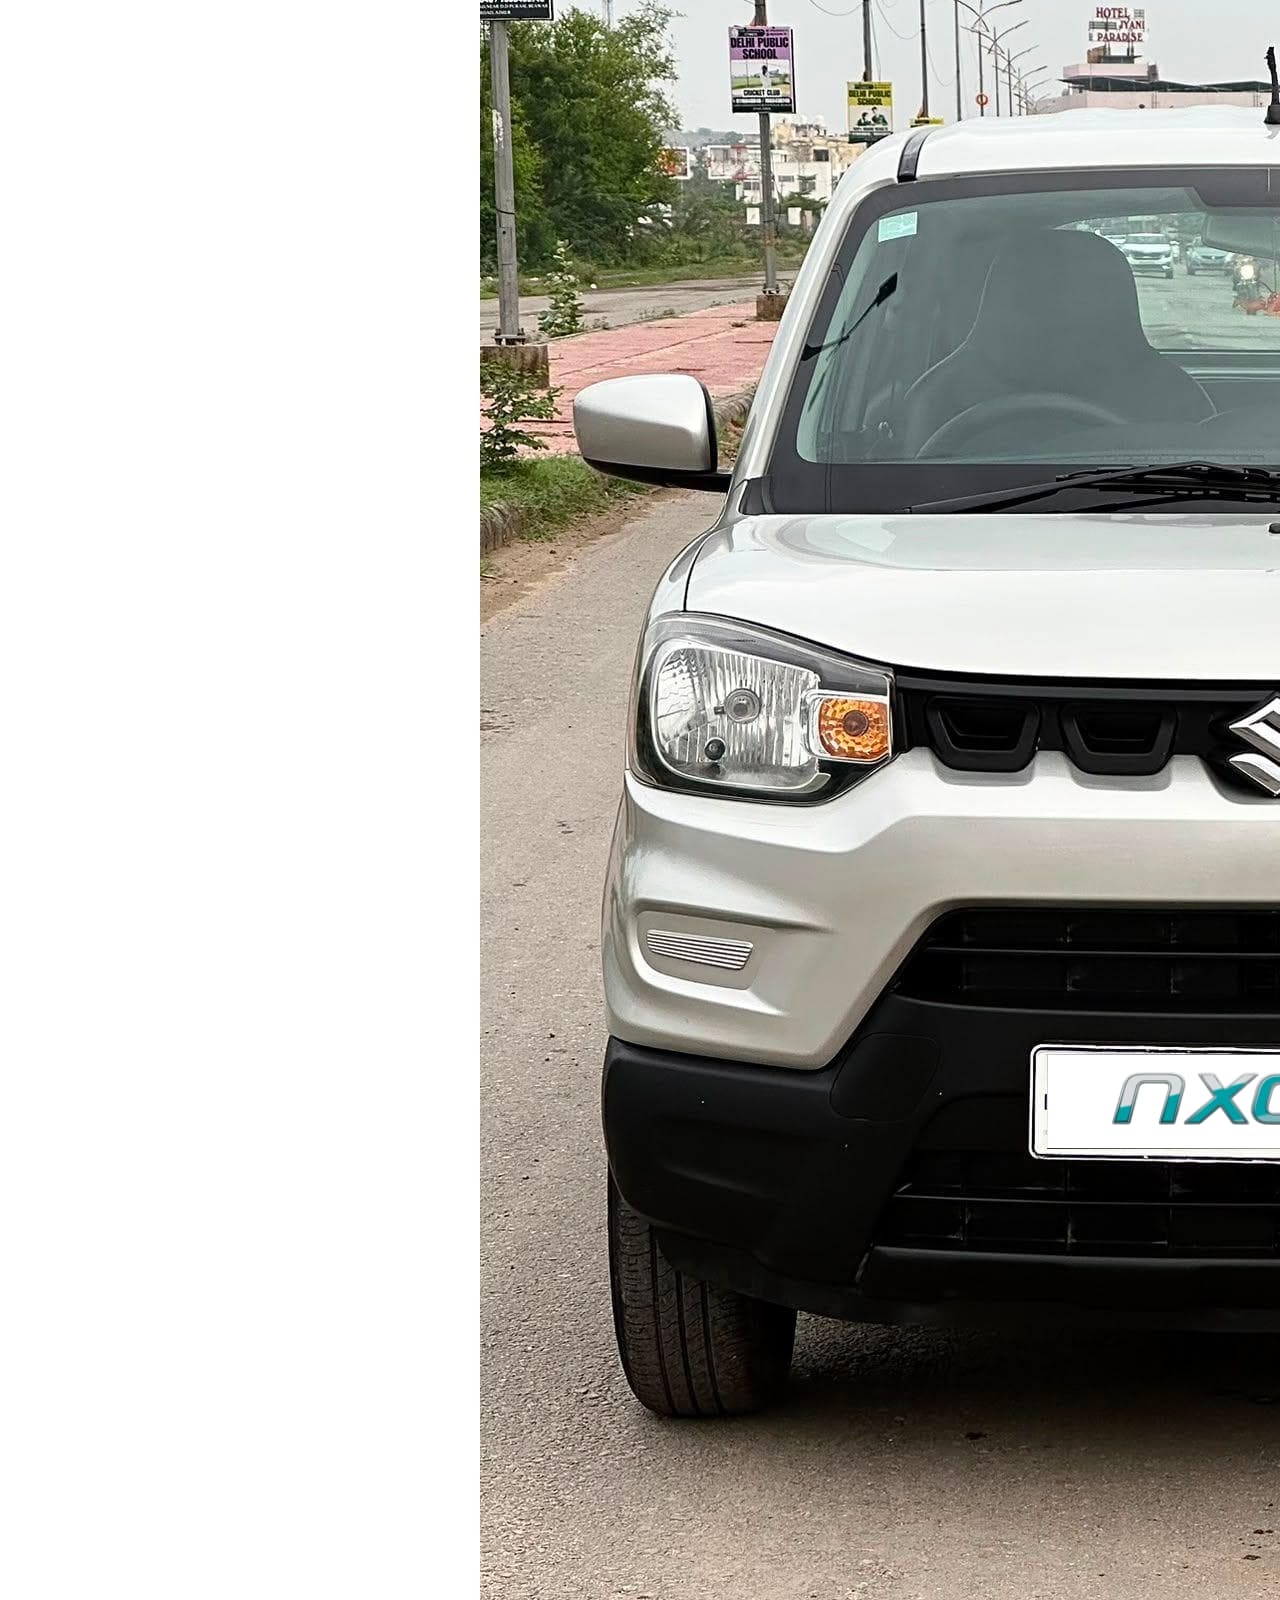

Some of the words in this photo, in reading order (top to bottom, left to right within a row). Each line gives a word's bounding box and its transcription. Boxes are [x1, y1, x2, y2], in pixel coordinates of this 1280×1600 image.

[1096, 7, 1130, 19] HOTEL
[730, 37, 755, 48] DELHI
[757, 37, 789, 48] PUBLIC
[1097, 32, 1144, 42] PARADISE
[742, 48, 778, 59] SCHOOL
